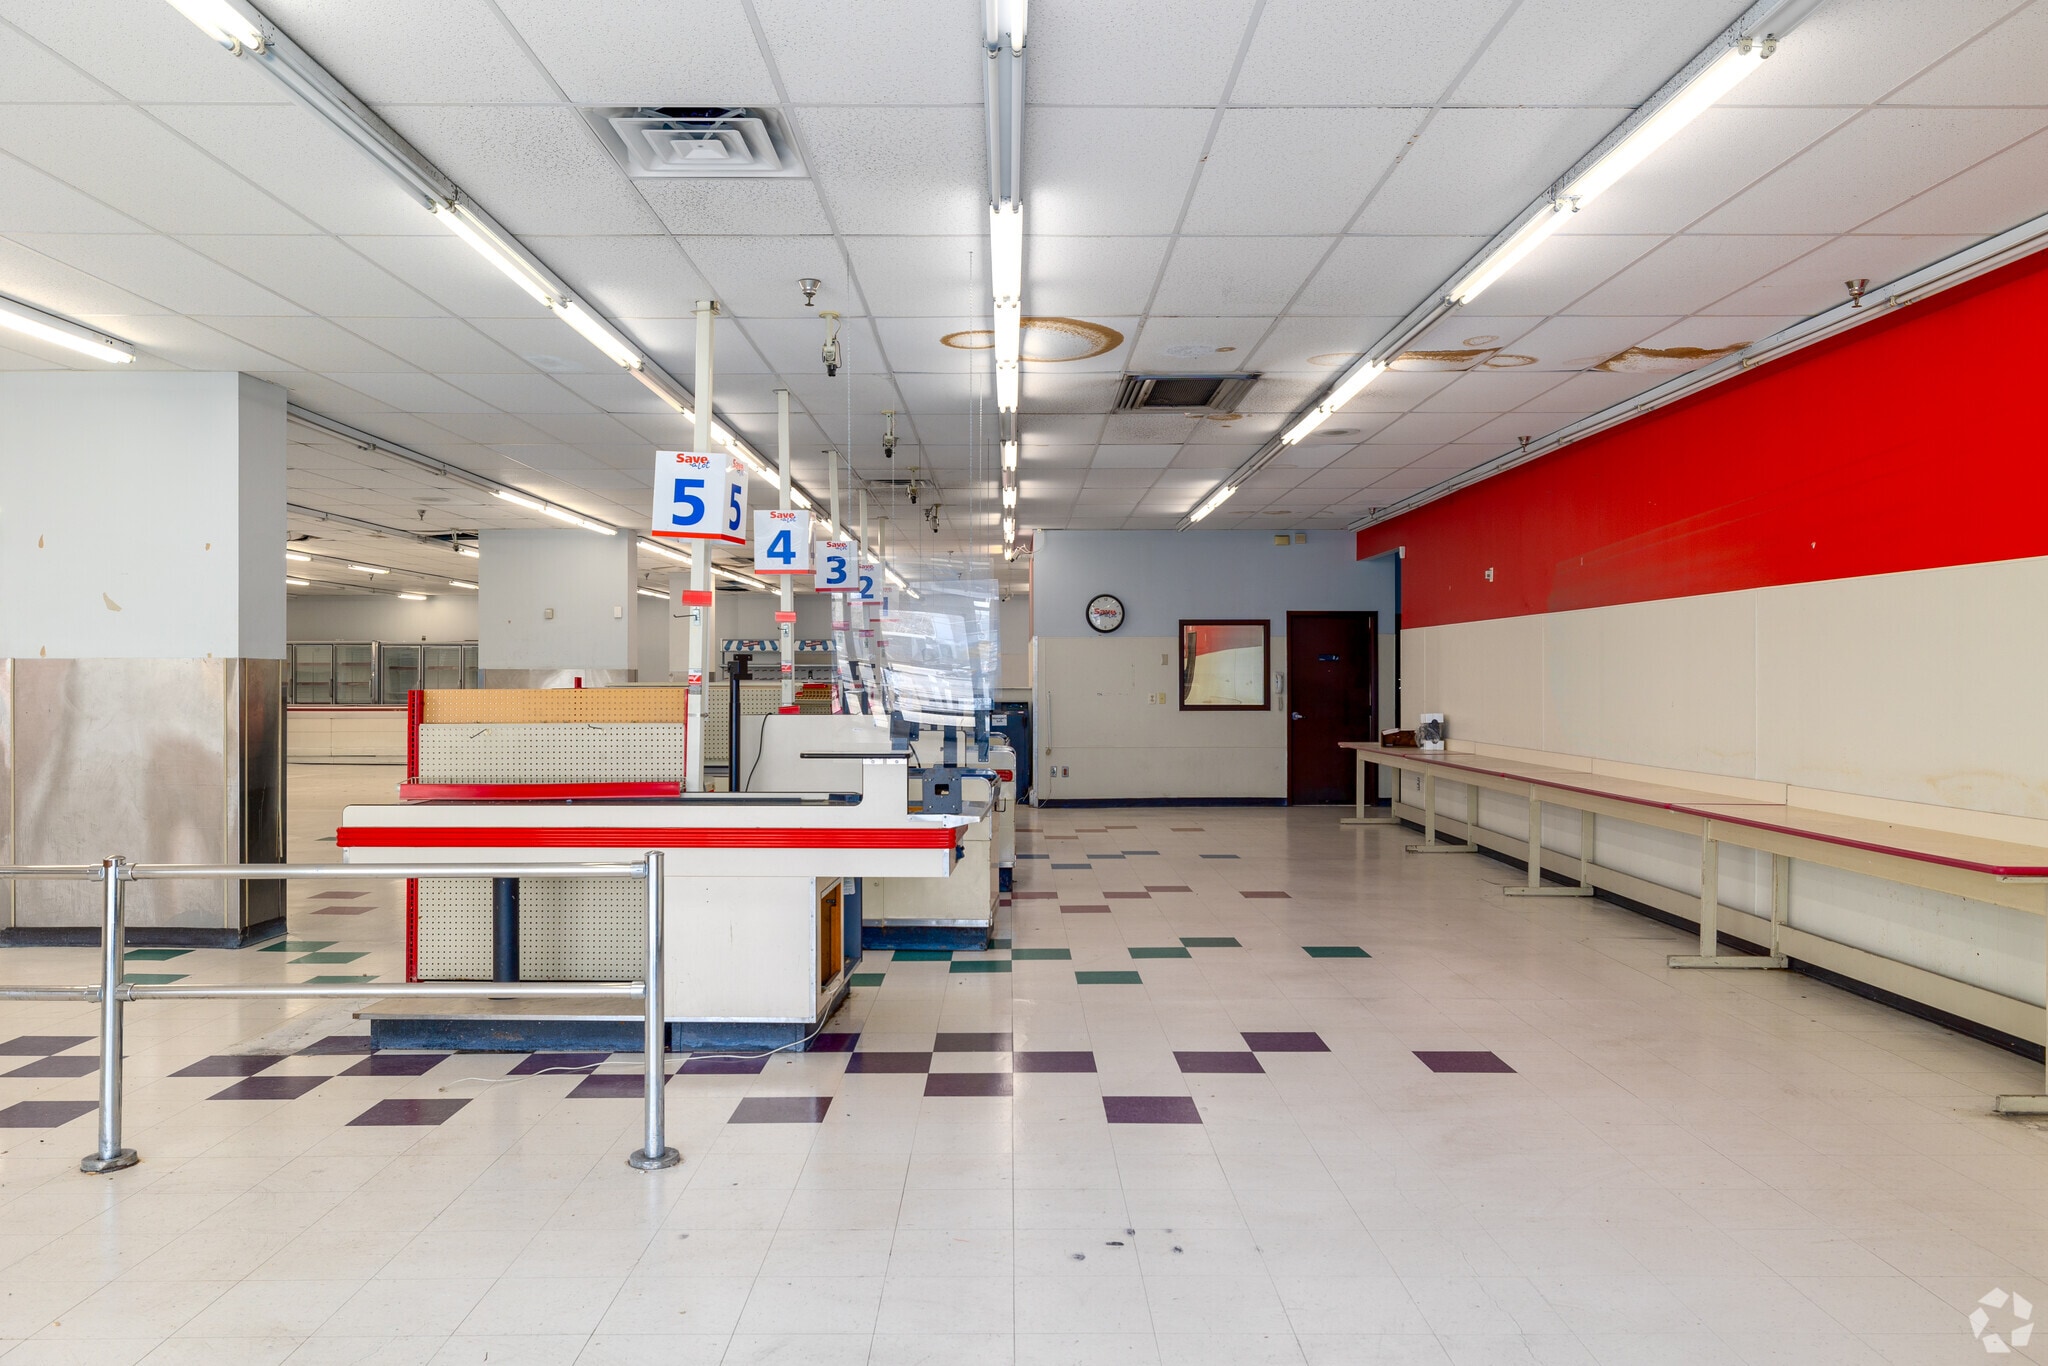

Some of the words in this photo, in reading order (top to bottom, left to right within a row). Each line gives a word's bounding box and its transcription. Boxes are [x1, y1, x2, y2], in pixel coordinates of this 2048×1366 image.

[676, 453, 709, 464] Save
[672, 478, 705, 526] 5
[729, 483, 742, 531] 5
[770, 511, 795, 519] Save
[767, 530, 796, 565] 4
[826, 555, 847, 585] 3
[860, 575, 874, 599] 2
